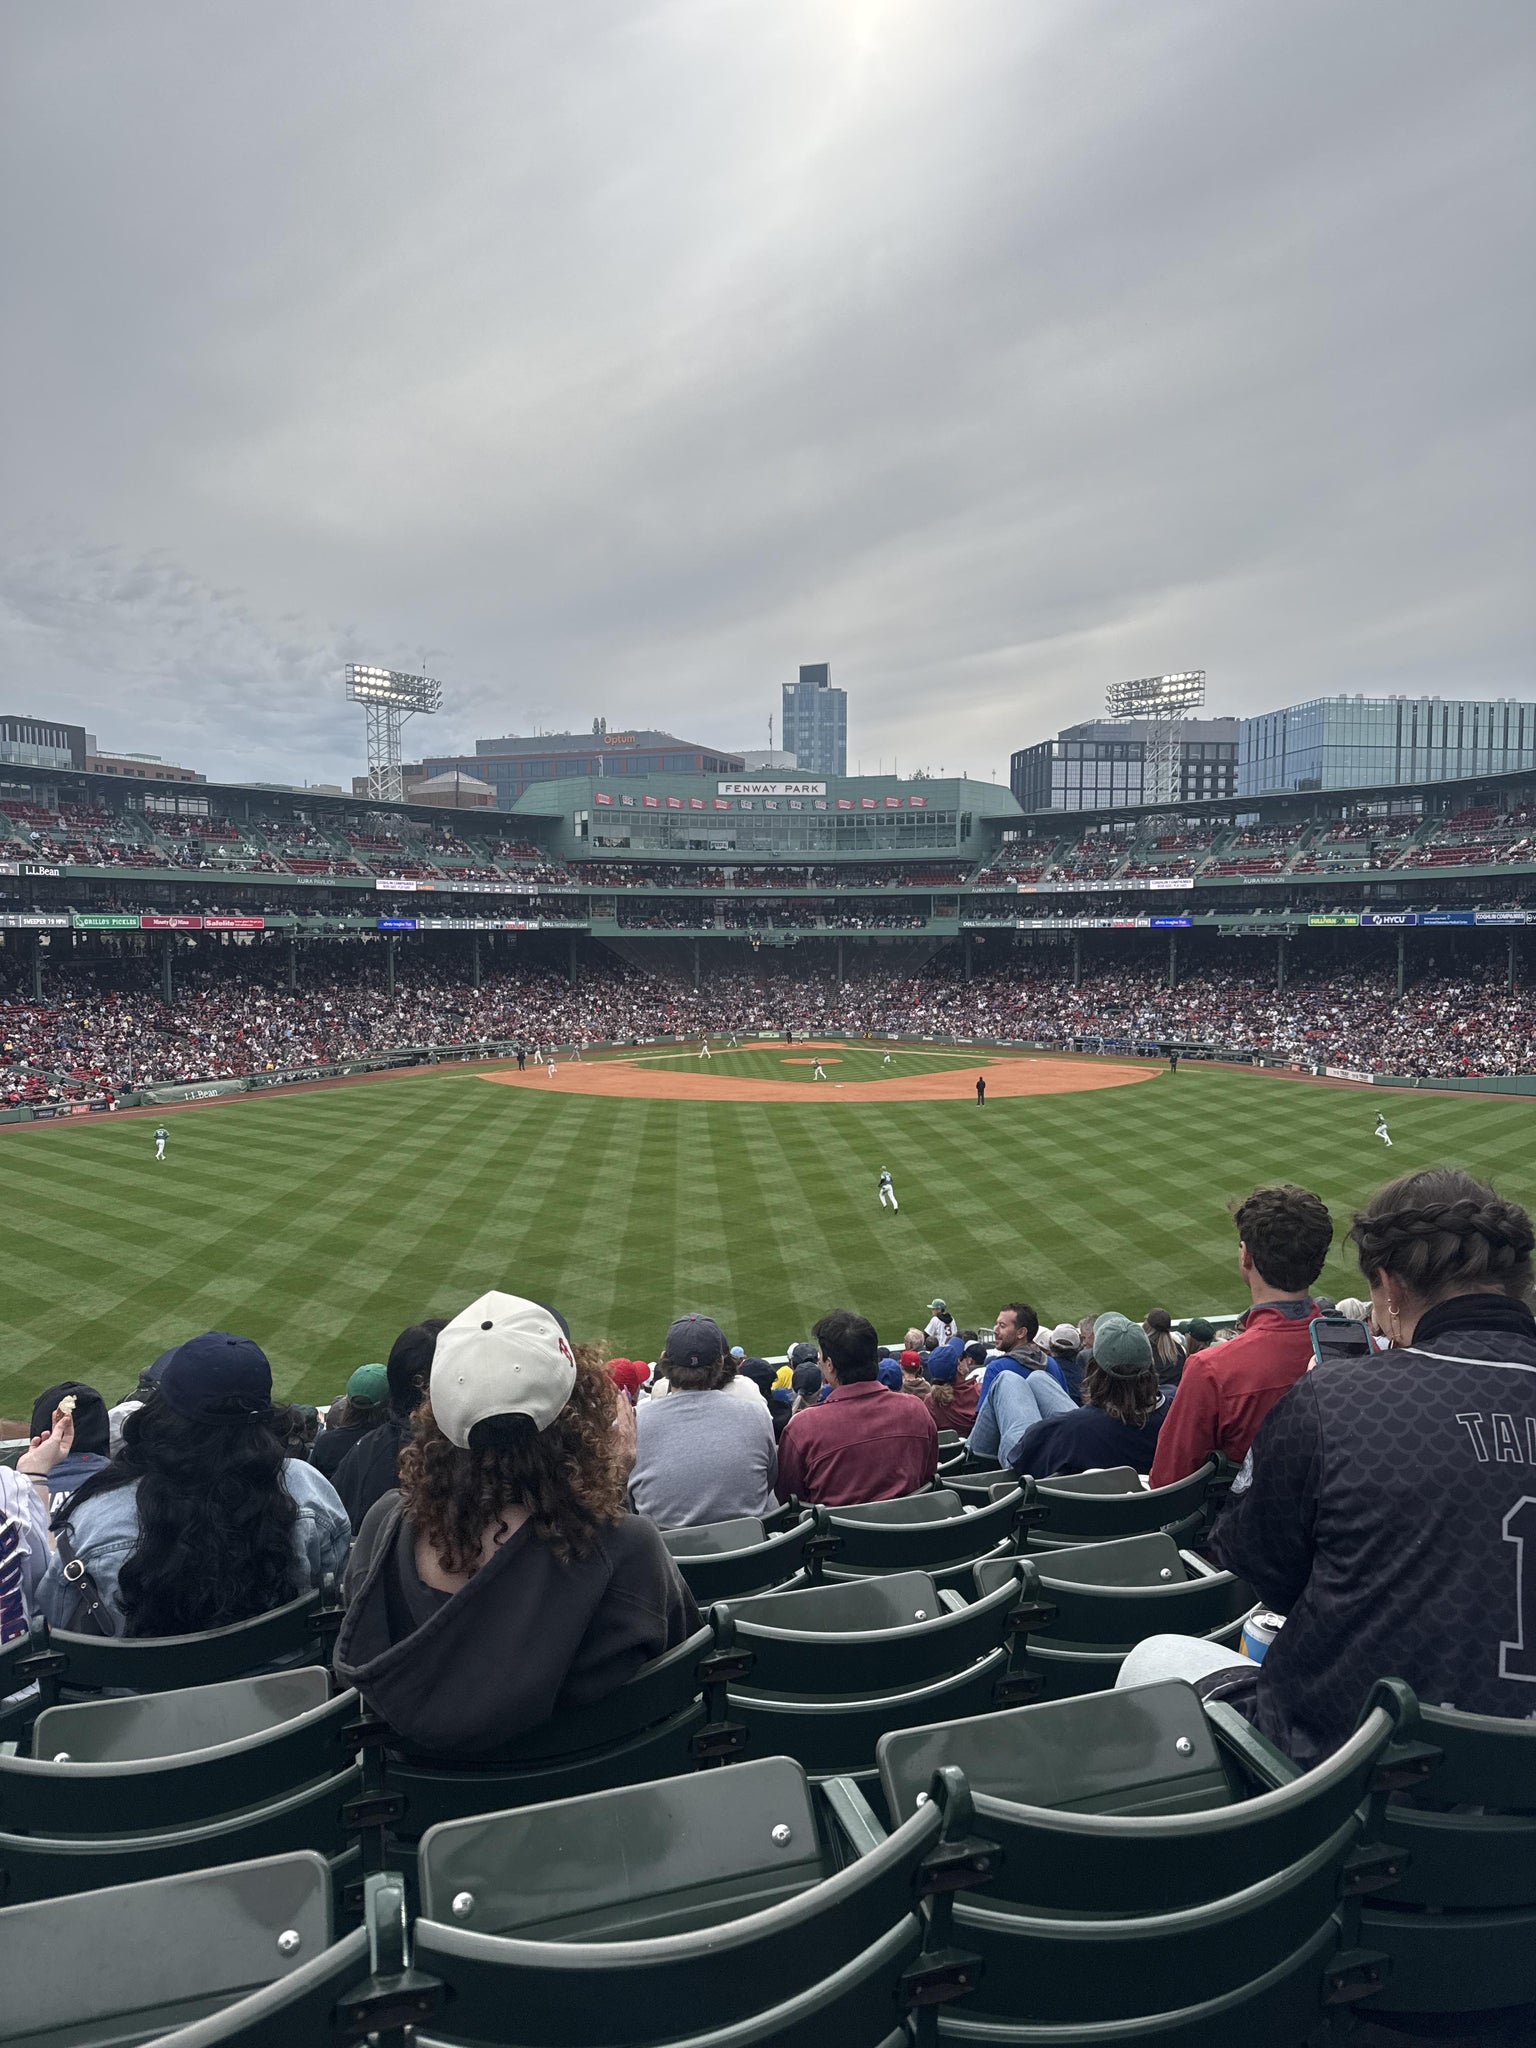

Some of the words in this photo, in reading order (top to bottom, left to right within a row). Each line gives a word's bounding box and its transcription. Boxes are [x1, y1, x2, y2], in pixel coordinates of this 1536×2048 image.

[604, 735, 635, 745] Optum
[725, 784, 776, 793] FENWAY
[784, 784, 819, 793] PARK
[25, 865, 60, 876] L.L.Bean
[184, 1089, 218, 1100] L.L.Bean
[944, 1324, 952, 1337] 3
